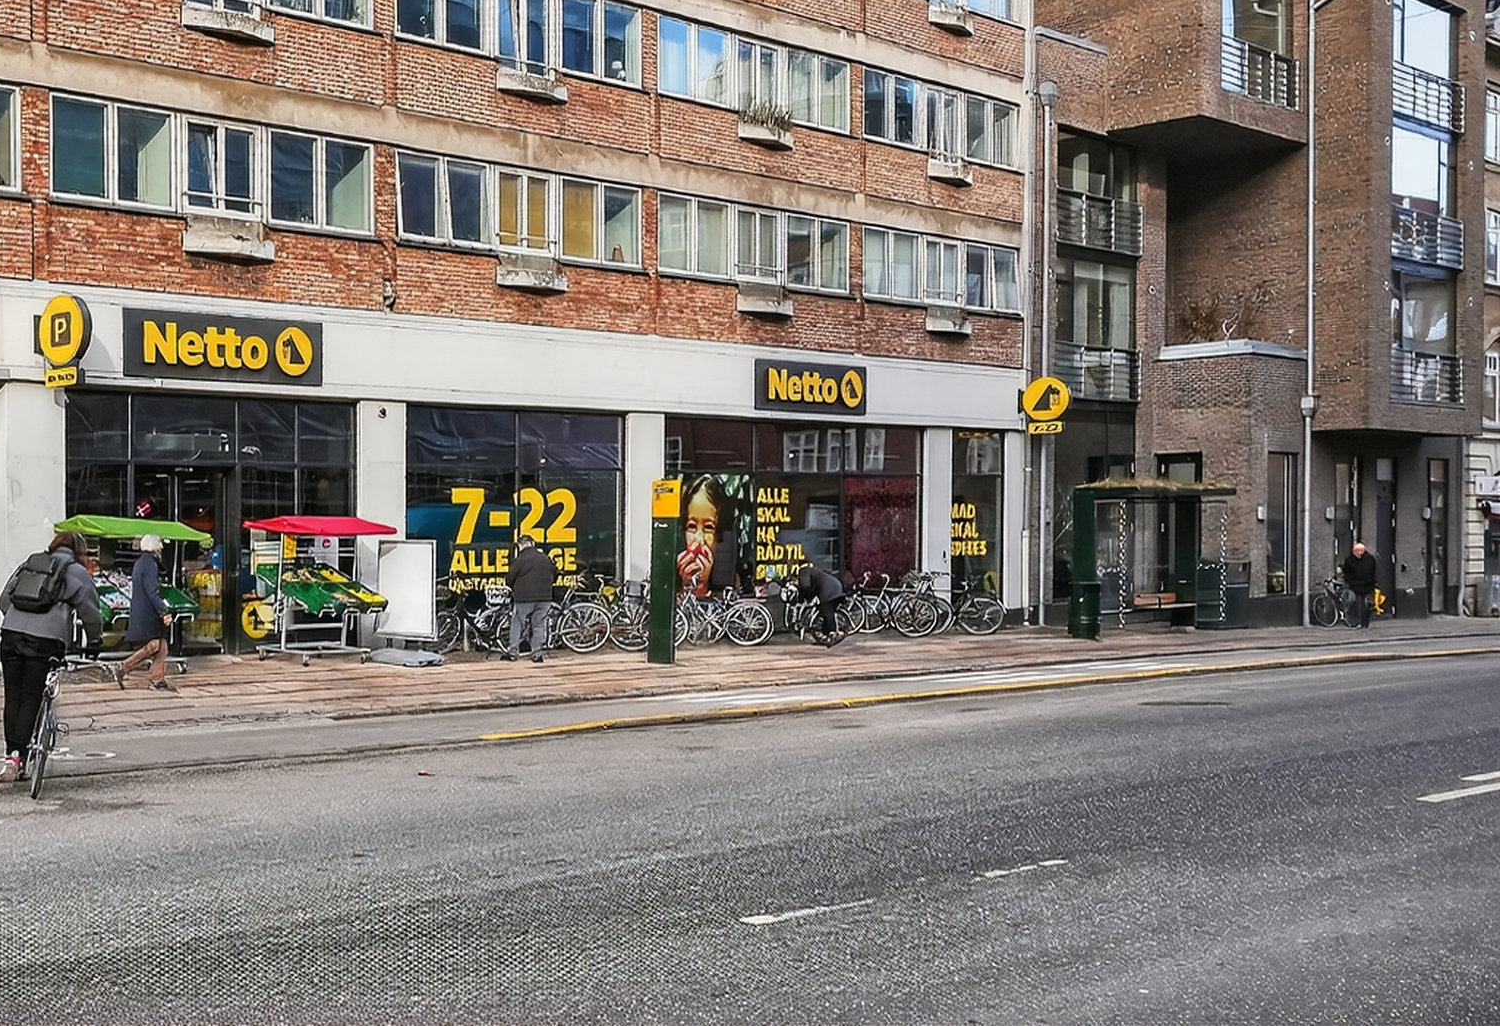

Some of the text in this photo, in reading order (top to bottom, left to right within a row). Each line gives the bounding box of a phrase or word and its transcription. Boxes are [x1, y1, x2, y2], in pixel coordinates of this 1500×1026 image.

[53, 318, 68, 343] P
[143, 320, 269, 371] Netto
[768, 367, 838, 404] Netto
[756, 487, 790, 505] ALLE
[451, 487, 577, 544] 7-22
[756, 506, 791, 523] SKAL
[450, 548, 509, 574] ALLE
[785, 543, 806, 561] TIL
